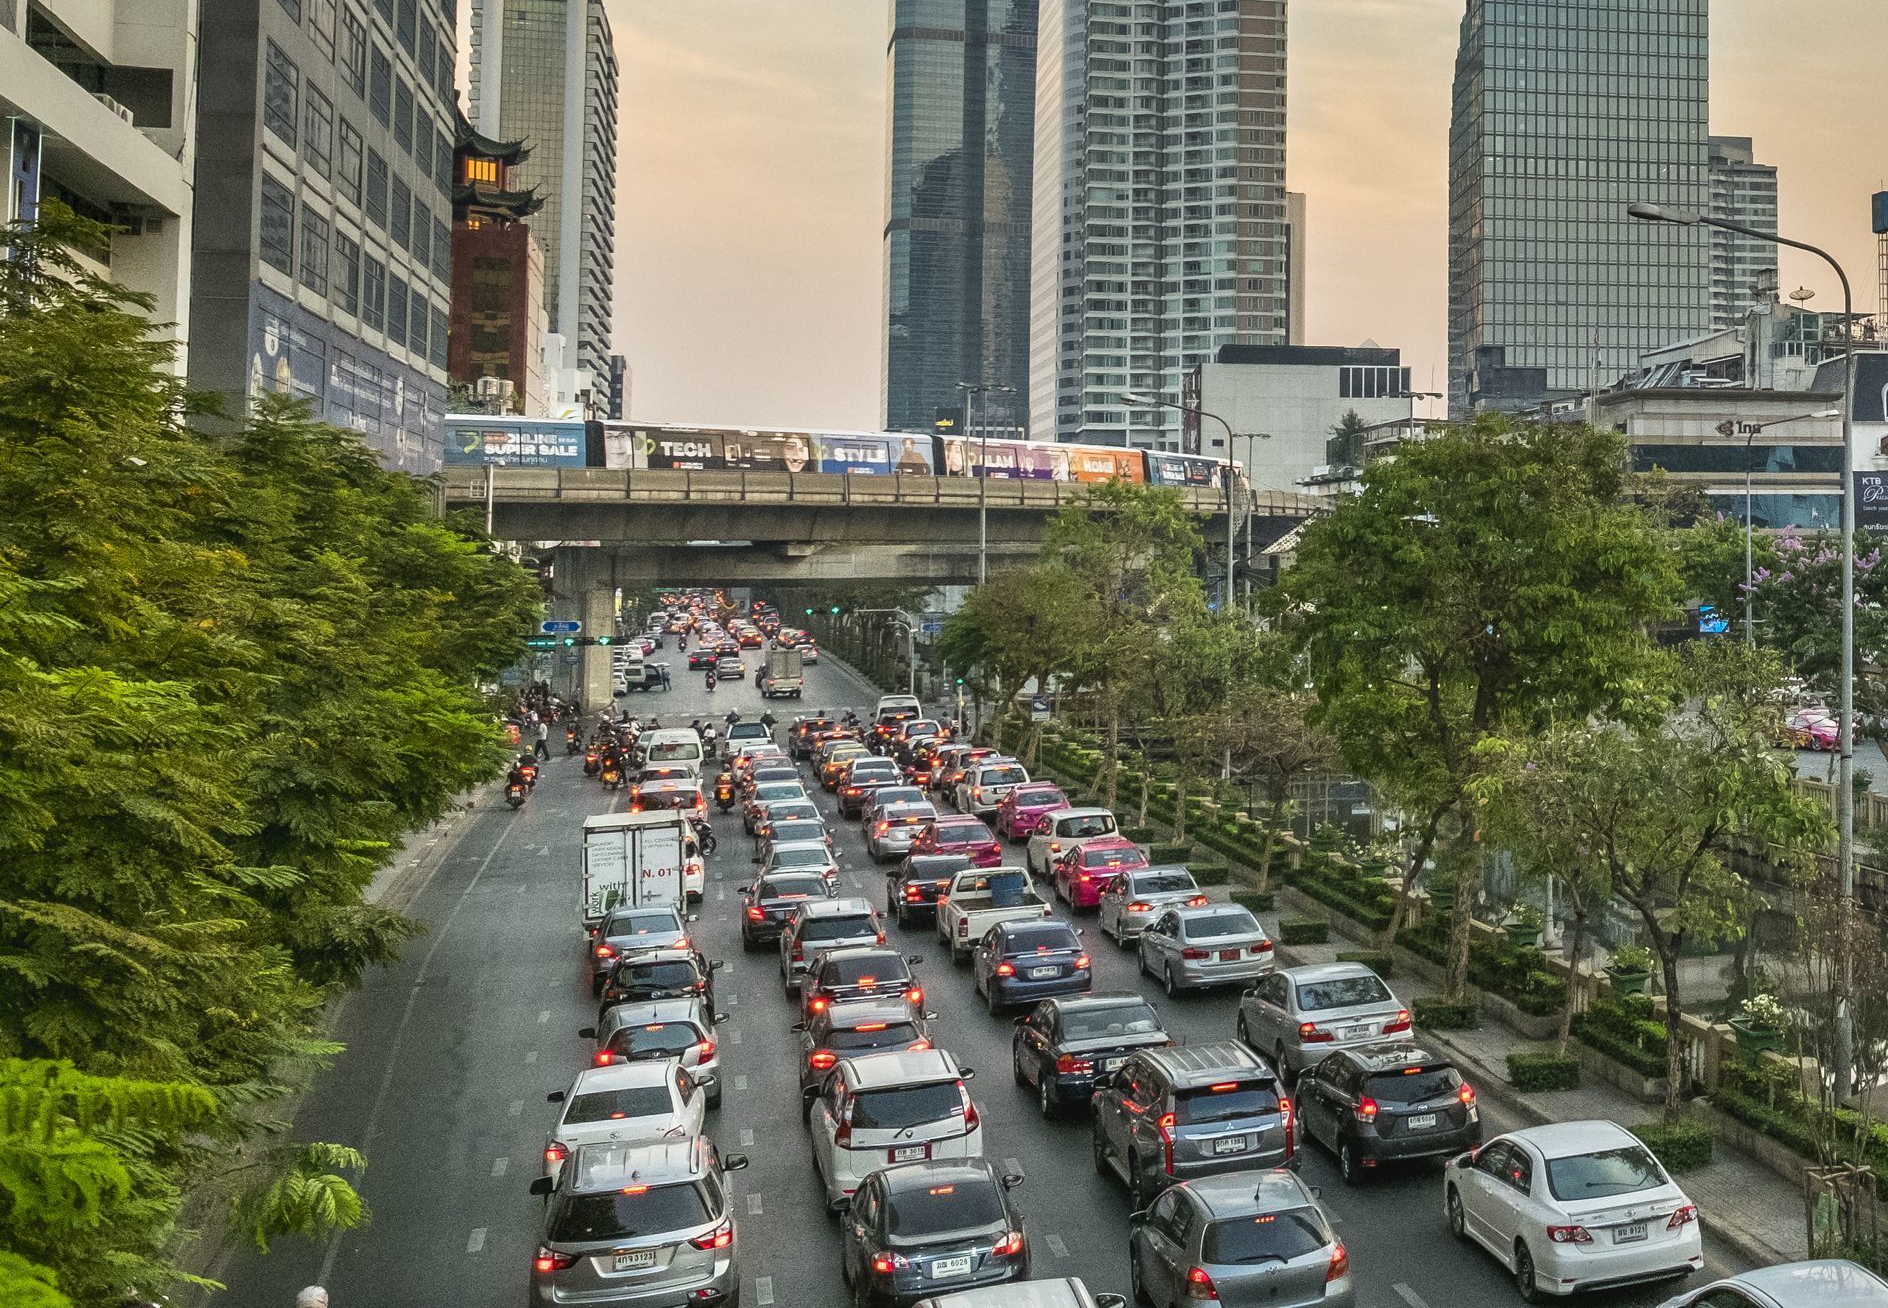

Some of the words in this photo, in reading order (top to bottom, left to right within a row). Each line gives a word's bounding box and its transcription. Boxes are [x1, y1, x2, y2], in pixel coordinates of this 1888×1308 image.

[507, 433, 558, 445] ONLINE
[484, 443, 538, 455] SUPER
[538, 445, 578, 456] SALE
[660, 441, 711, 458] TECH
[833, 447, 886, 463] STYLE
[1083, 460, 1114, 474] HOME
[1862, 477, 1881, 485] KTB
[599, 881, 626, 891] with
[591, 891, 600, 915] work
[634, 1252, 653, 1262] 3123
[950, 1258, 968, 1267] 6028
